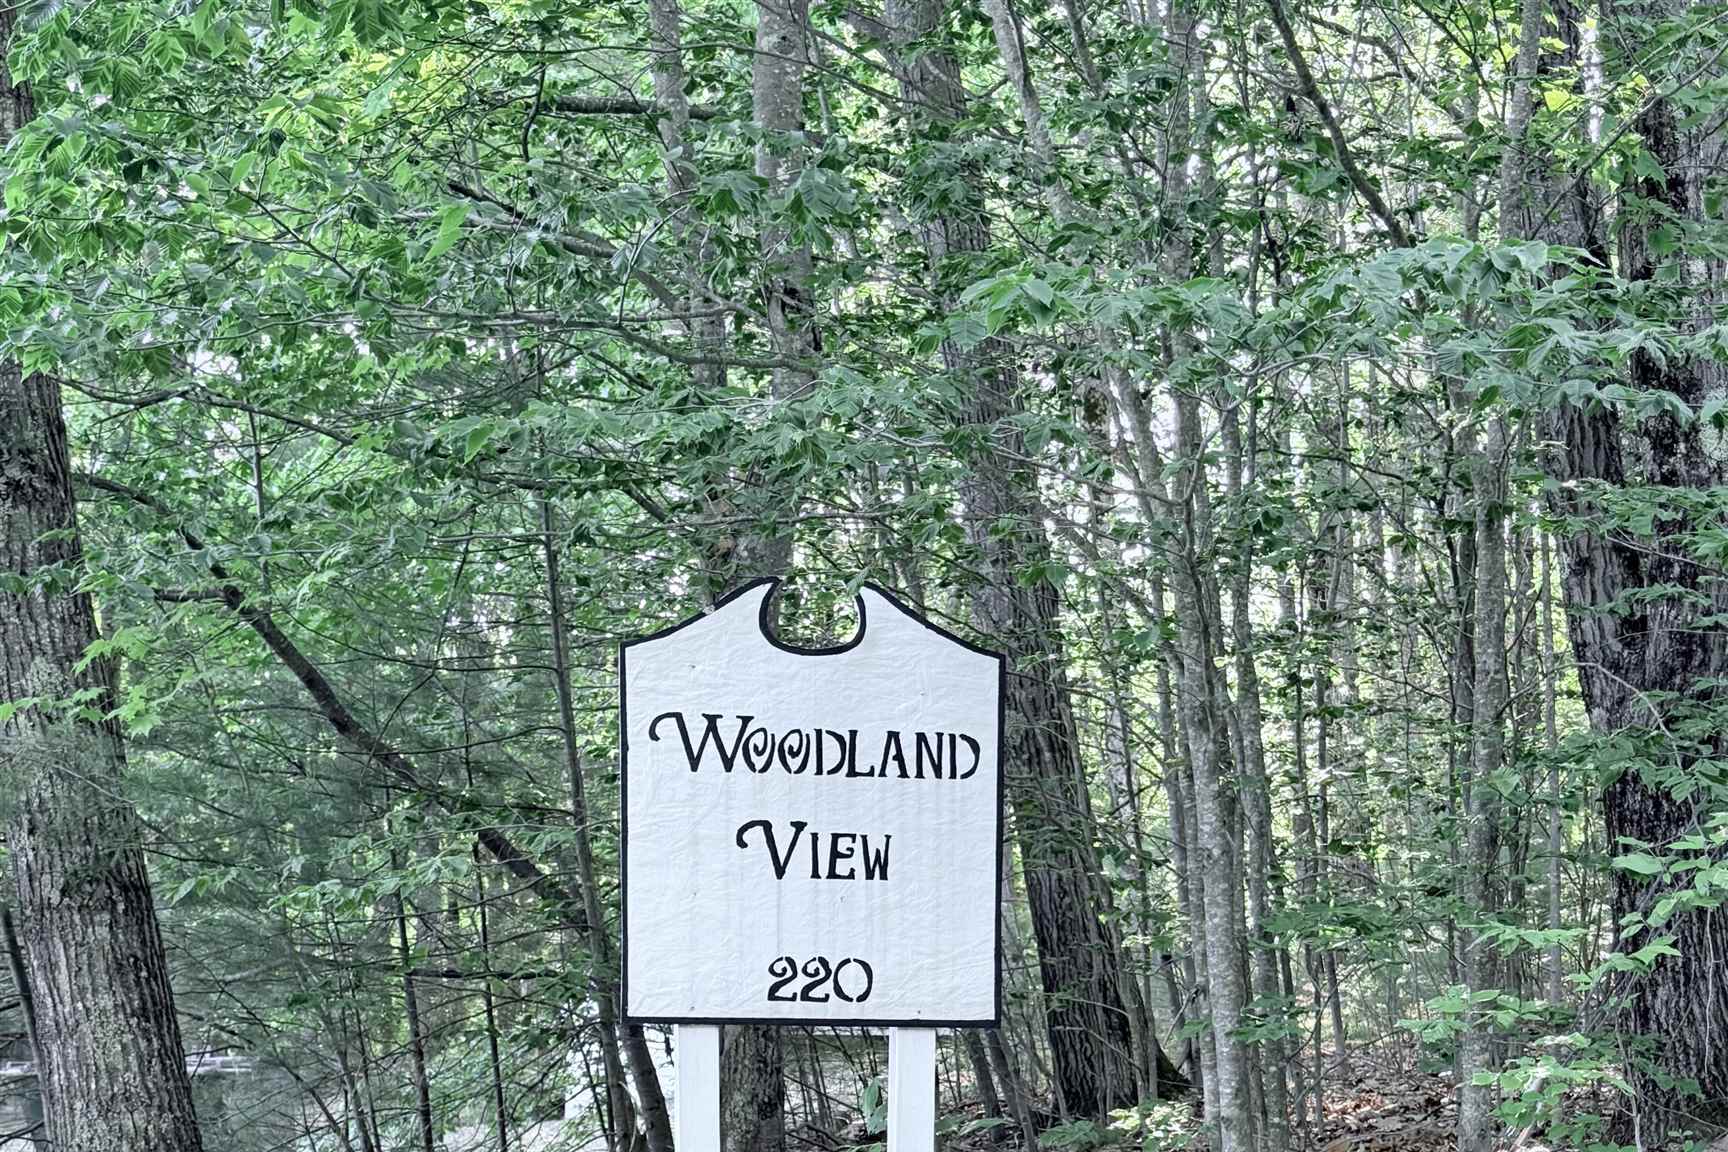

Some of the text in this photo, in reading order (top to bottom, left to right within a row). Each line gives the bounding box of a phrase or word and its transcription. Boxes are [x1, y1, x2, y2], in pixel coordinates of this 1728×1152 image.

[648, 711, 981, 780] WOODLAND
[735, 819, 892, 881] VIEW
[767, 956, 874, 1003] 220
